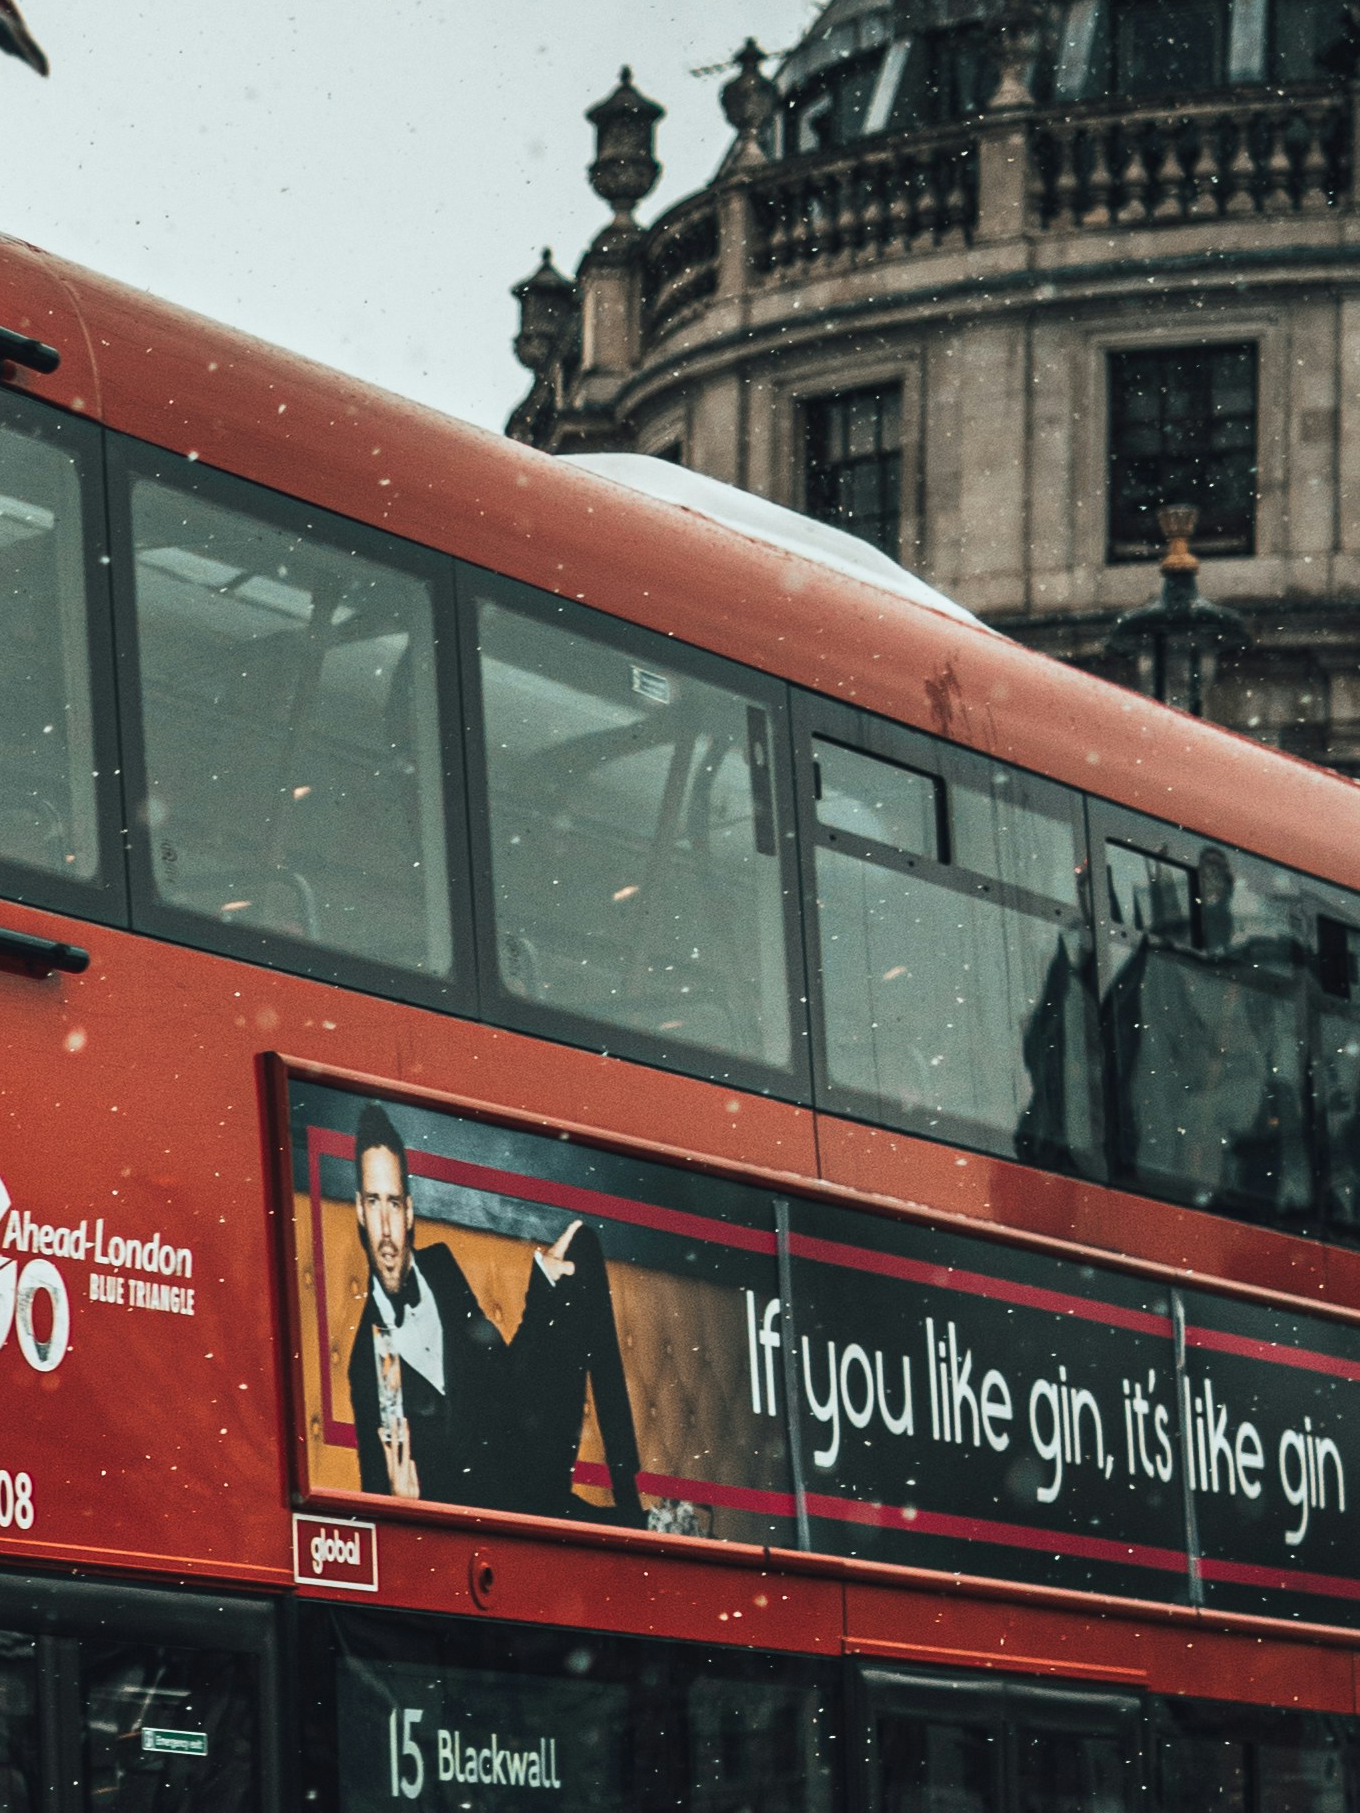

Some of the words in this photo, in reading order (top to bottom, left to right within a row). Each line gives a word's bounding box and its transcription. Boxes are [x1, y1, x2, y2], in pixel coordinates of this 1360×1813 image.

[89, 1273, 124, 1306] BLUE
[129, 1277, 196, 1317] TRIANGLE
[745, 1290, 781, 1417] If
[802, 1335, 914, 1468] you
[926, 1317, 1013, 1452] like
[1029, 1366, 1115, 1504] gin,
[1124, 1368, 1172, 1483] it's
[1184, 1375, 1265, 1500] like
[1280, 1416, 1346, 1546] gin
[310, 1527, 362, 1574] global
[389, 1708, 424, 1800] 15
[437, 1729, 561, 1790] Blackwall
